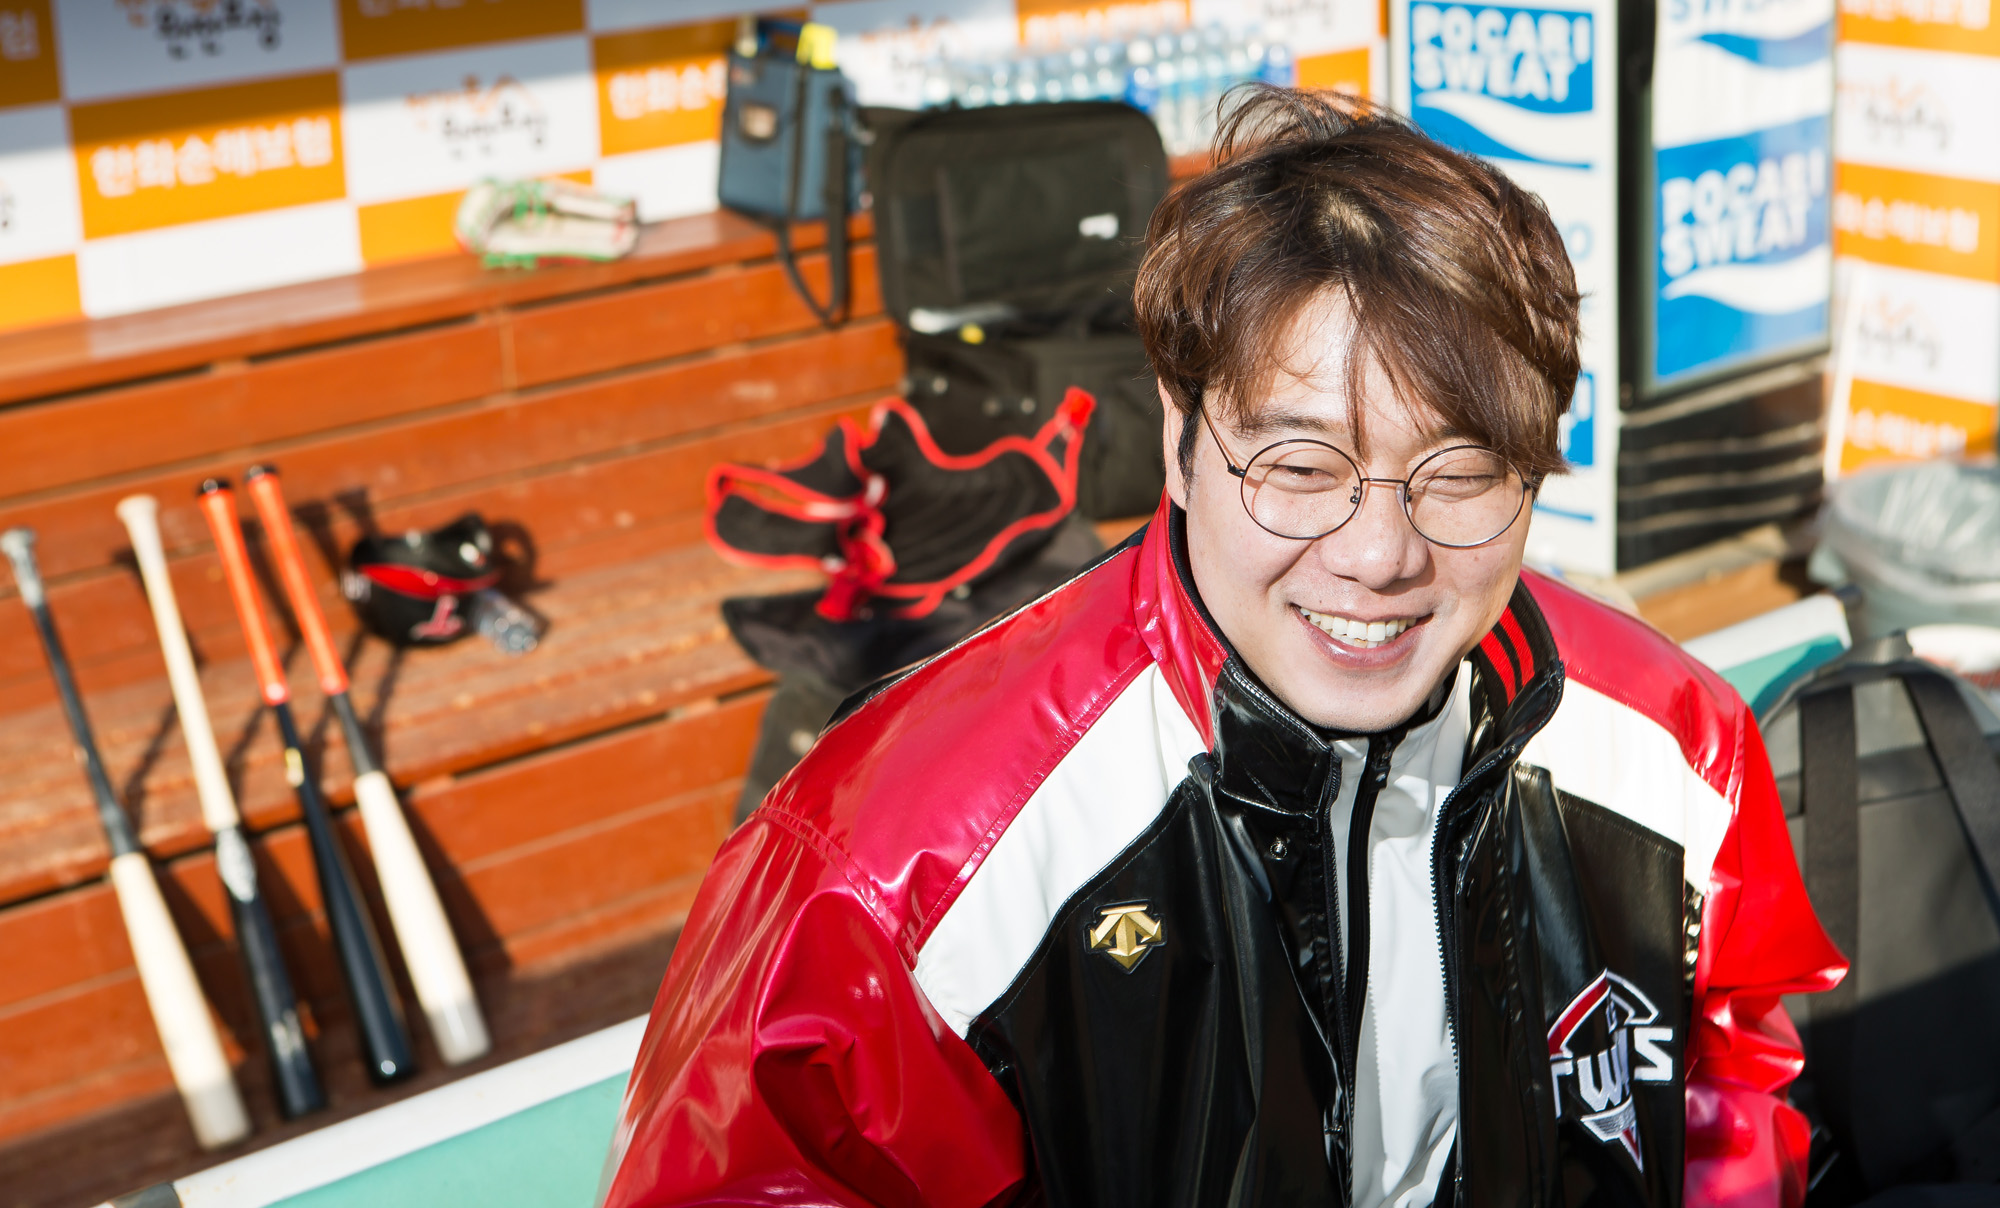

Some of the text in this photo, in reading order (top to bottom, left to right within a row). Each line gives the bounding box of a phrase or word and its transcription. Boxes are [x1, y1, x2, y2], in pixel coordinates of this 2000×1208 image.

[1411, 3, 1592, 65] POCARI
[1411, 47, 1578, 103] SWEAT
[1661, 148, 1826, 228] POCARI
[1660, 200, 1810, 278] SWEAT
